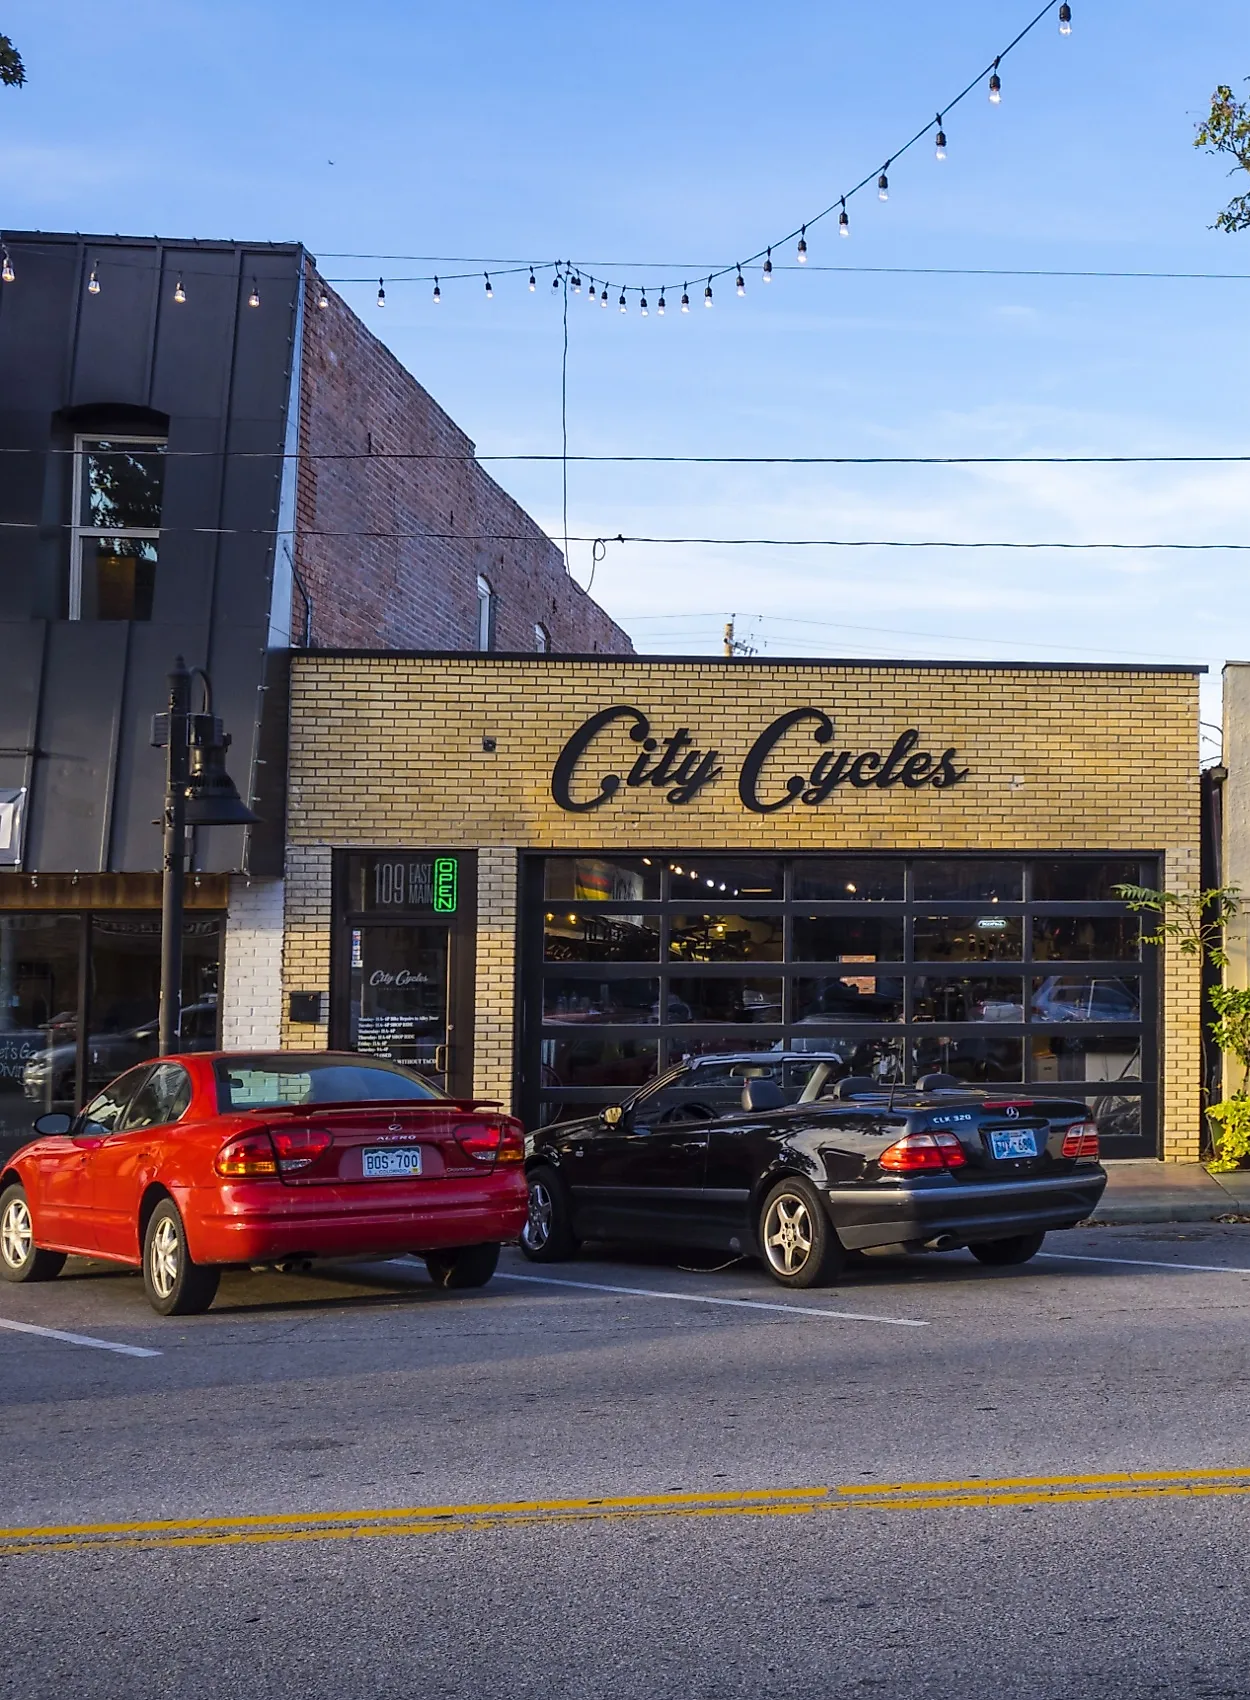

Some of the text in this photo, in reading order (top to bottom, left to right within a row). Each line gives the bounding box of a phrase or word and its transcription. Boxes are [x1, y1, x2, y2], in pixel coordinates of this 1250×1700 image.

[551, 705, 969, 813] City Cycles
[374, 863, 433, 904] 109 EAST
[408, 884, 434, 904] MAIN
[439, 861, 453, 909] OPEN
[370, 970, 428, 986] City Cycles
[933, 1114, 972, 1124] CLK 320
